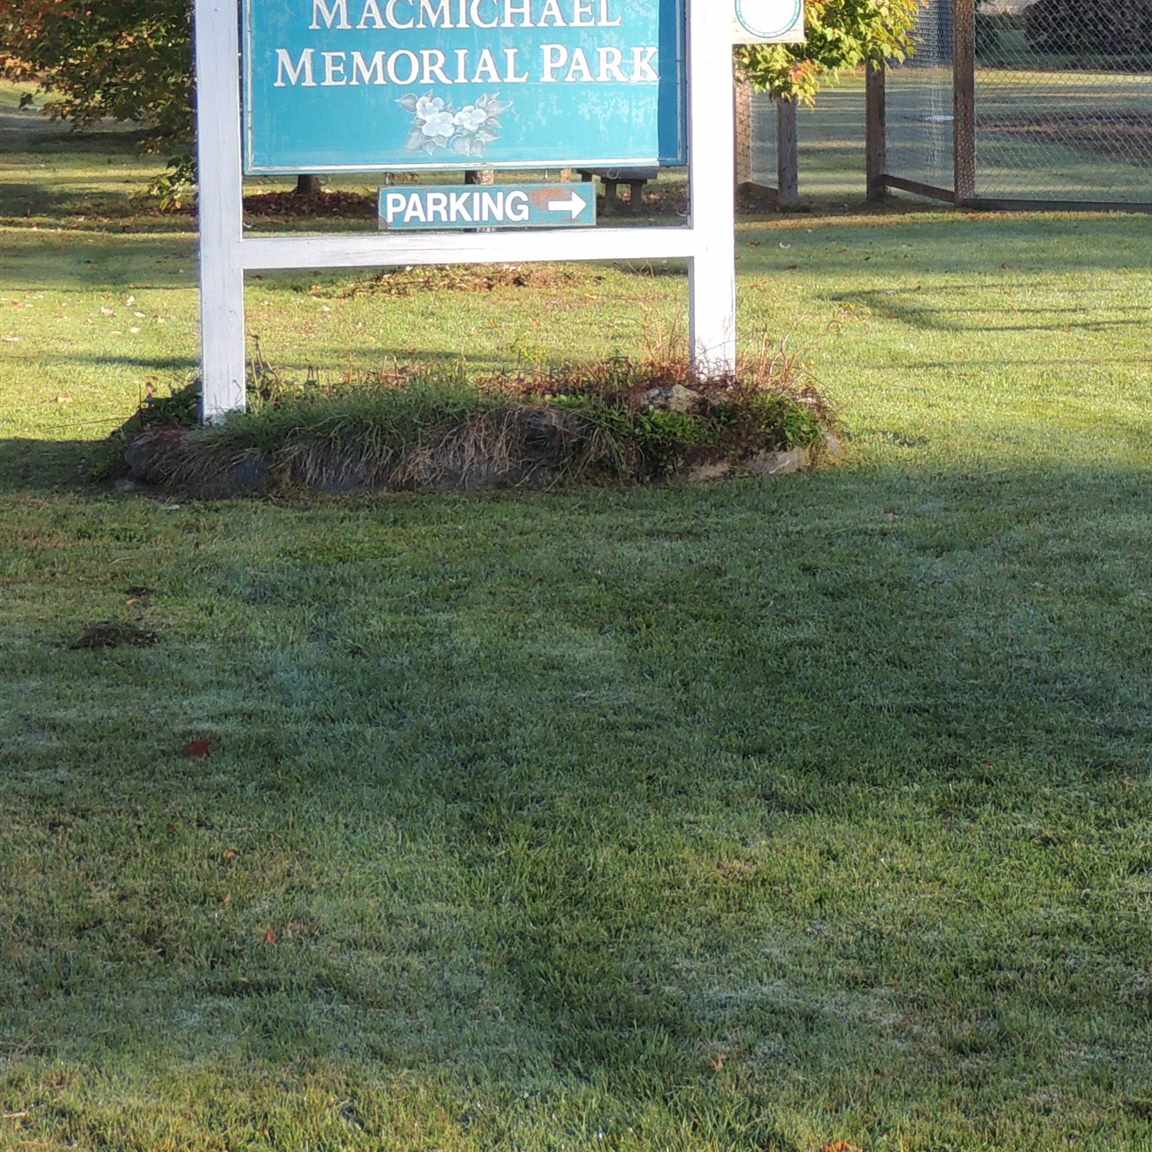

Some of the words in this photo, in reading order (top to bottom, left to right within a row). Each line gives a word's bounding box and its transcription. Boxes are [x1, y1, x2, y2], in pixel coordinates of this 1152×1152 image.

[273, 48, 529, 87] MEMORIAL
[538, 44, 660, 83] PARK
[386, 190, 530, 223] PARKING
